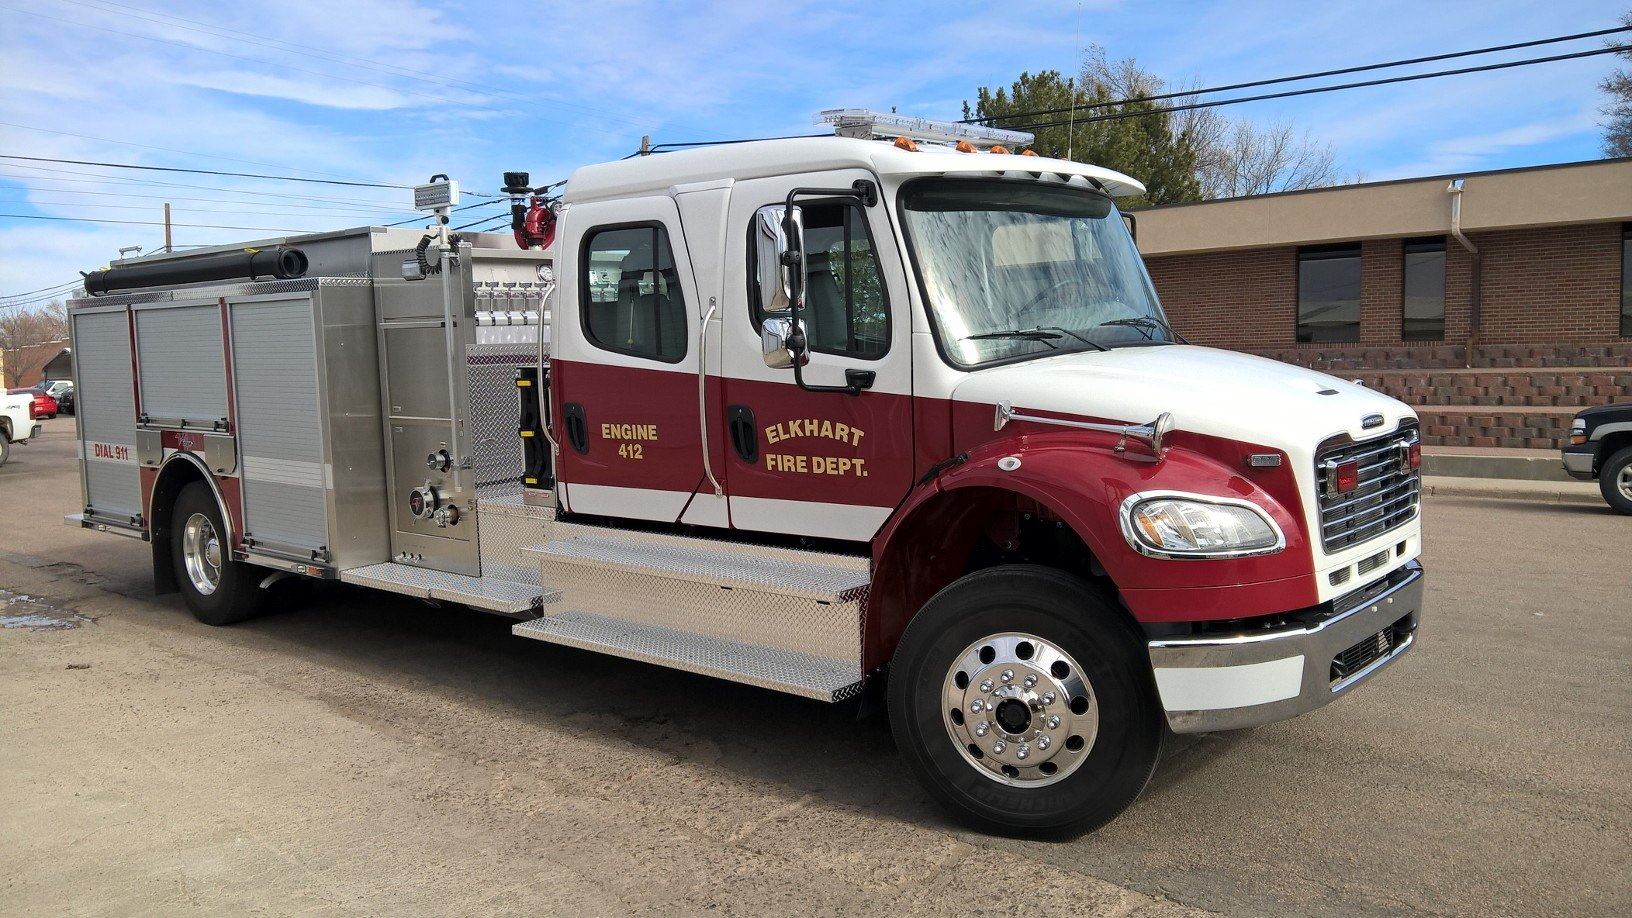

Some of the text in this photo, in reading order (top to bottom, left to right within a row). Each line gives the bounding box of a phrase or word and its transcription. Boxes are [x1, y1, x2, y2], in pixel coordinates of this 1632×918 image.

[601, 423, 658, 441] ENGINE
[764, 419, 865, 447] ELKHART
[95, 443, 129, 460] DIAL 911
[618, 443, 643, 460] 412
[765, 453, 869, 477] FIRE DEPT.
